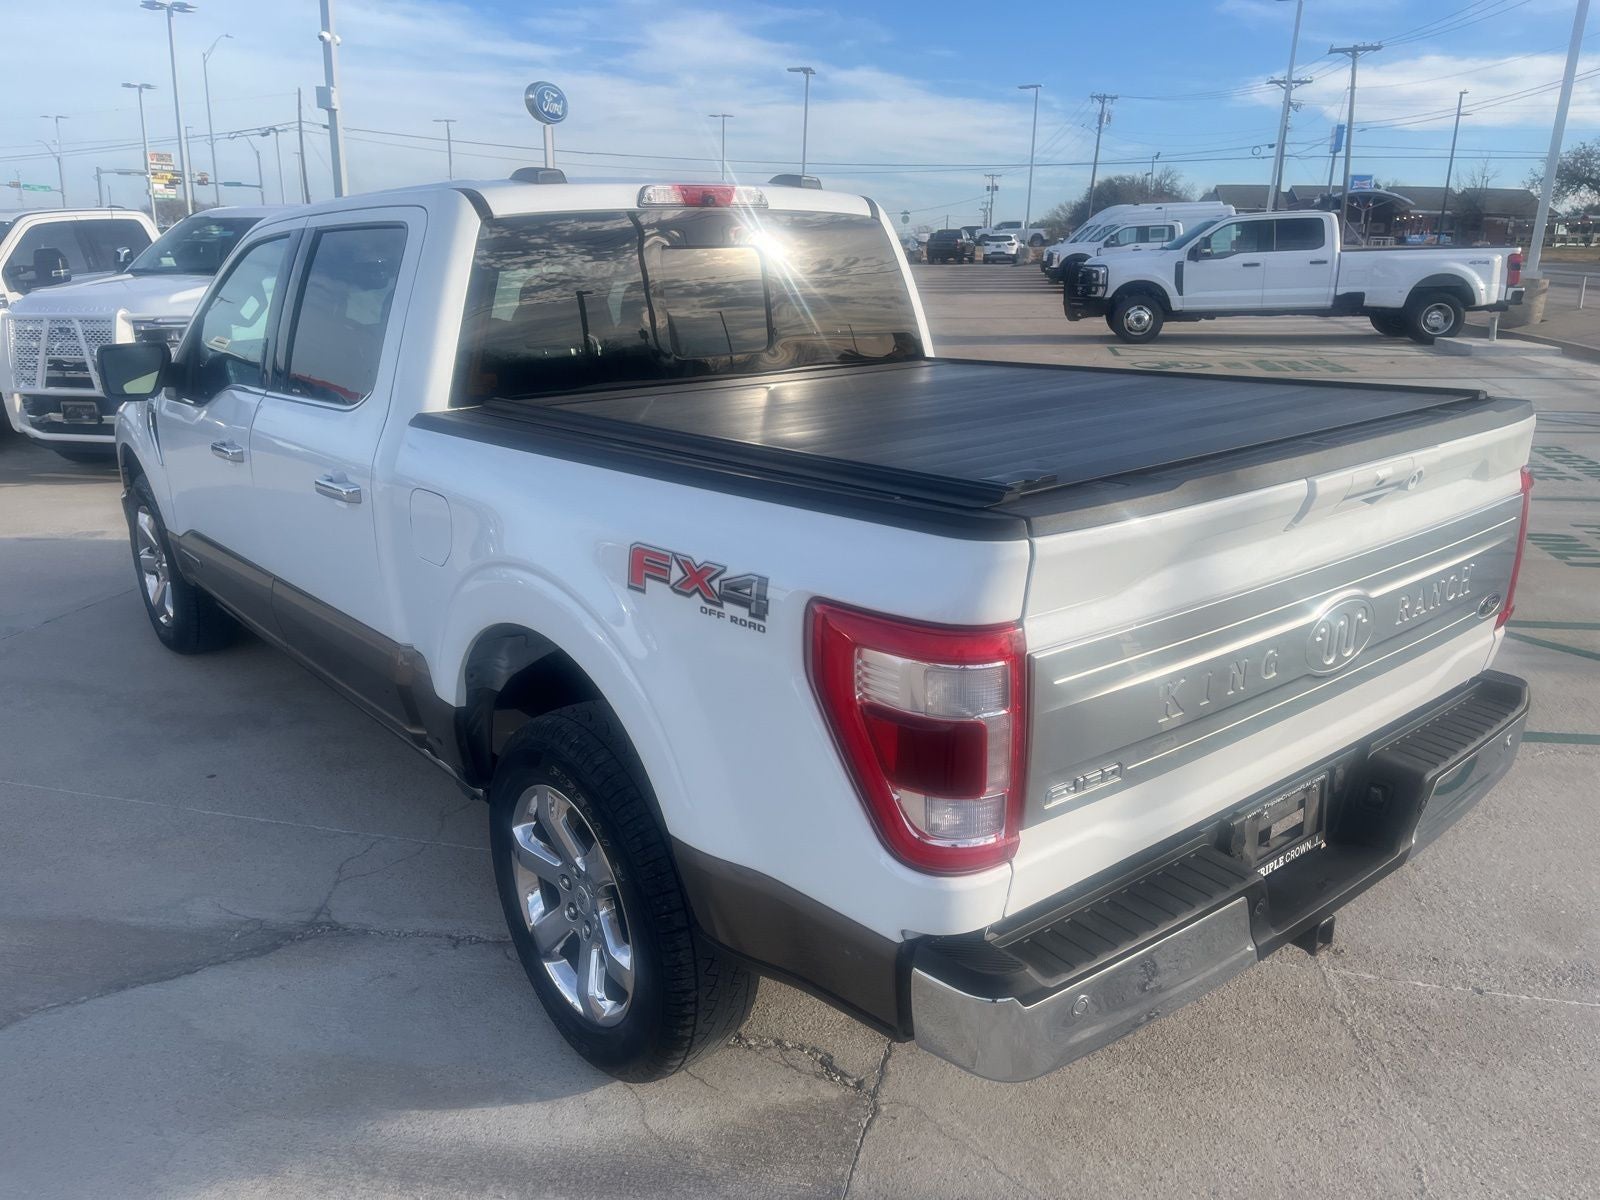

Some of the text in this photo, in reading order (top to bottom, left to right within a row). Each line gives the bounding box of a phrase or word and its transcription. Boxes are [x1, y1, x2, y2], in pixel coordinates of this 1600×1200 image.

[542, 89, 564, 116] Ford
[627, 541, 769, 622] FX4
[700, 606, 766, 634] OFF ROAD
[1158, 563, 1475, 723] KING RANCH
[1285, 839, 1312, 863] CROWN
